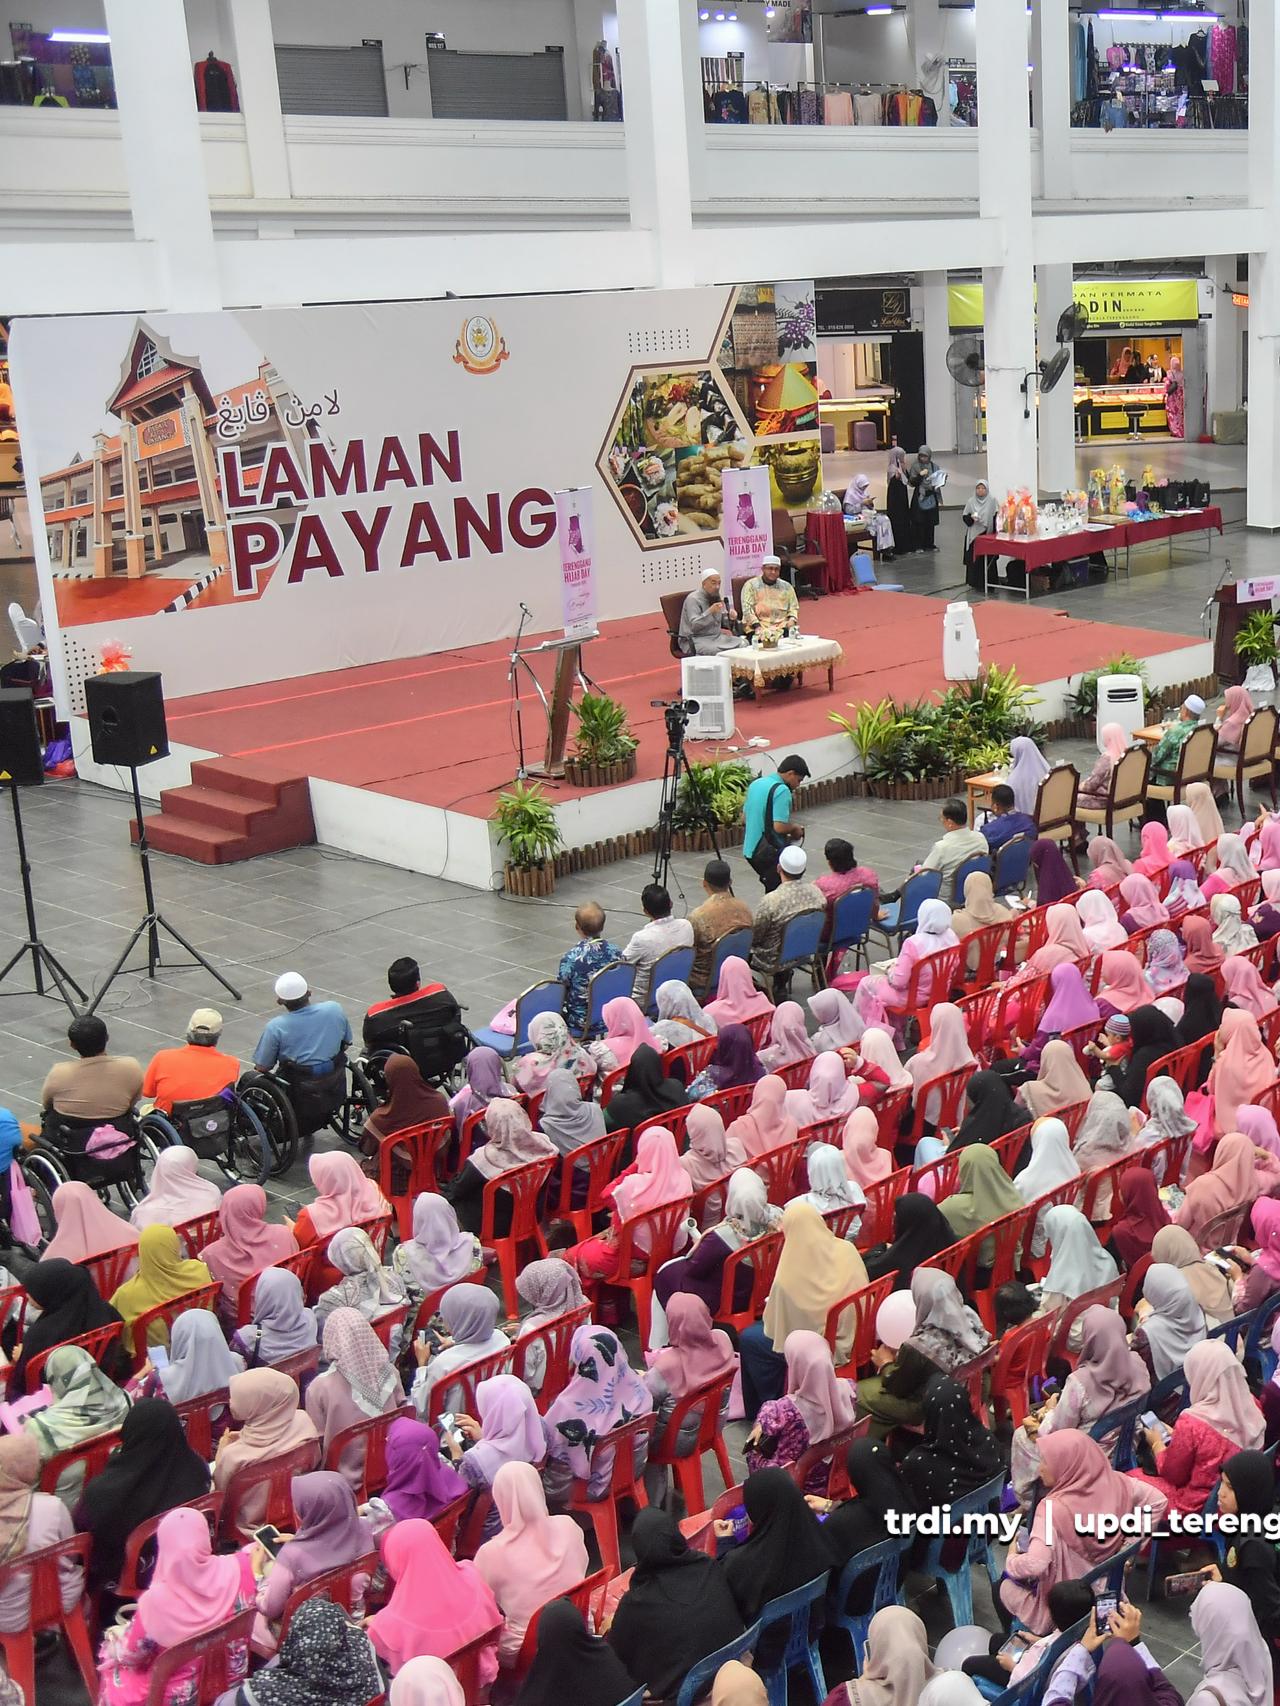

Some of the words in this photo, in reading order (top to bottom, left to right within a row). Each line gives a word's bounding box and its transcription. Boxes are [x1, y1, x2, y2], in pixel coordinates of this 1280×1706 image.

[1089, 300, 1122, 313] DIN
[222, 430, 463, 508] LAMAN
[230, 487, 557, 591] PAYANG
[728, 533, 768, 546] TERENGGANU
[729, 544, 751, 556] HIJAB
[751, 542, 767, 554] DAY
